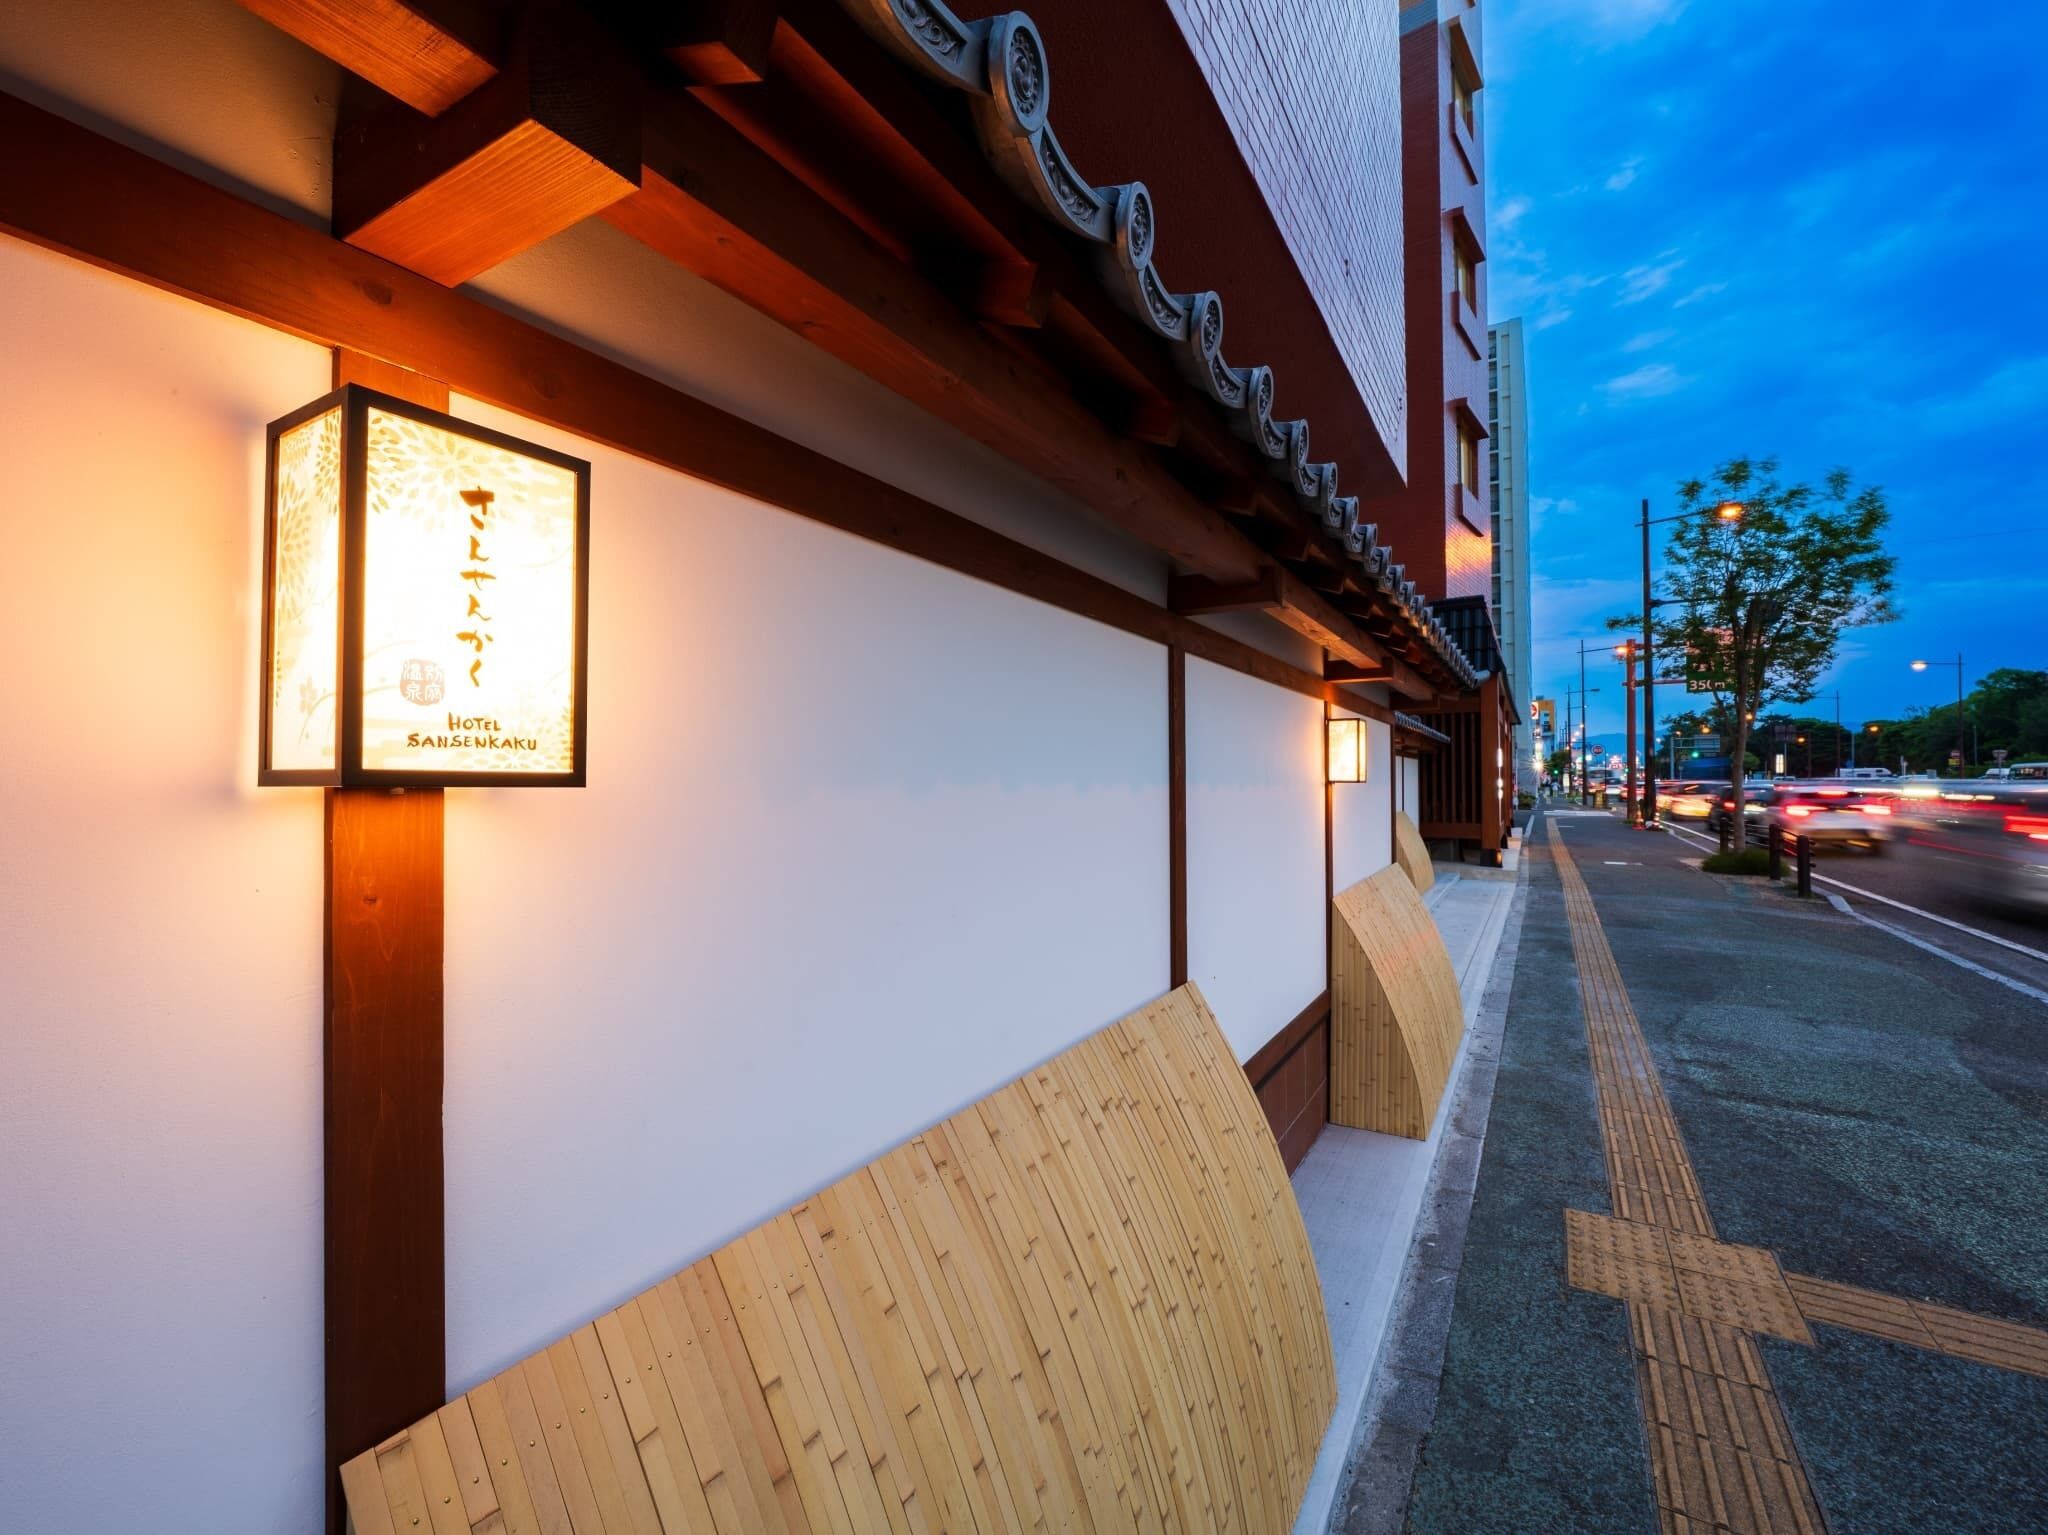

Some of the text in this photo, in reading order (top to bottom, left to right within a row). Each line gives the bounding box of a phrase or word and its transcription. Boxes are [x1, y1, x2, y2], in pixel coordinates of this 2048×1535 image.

[456, 486, 496, 687] さんせんかく
[448, 712, 501, 731] HOTEL
[407, 733, 537, 750] SANSENKAKU
